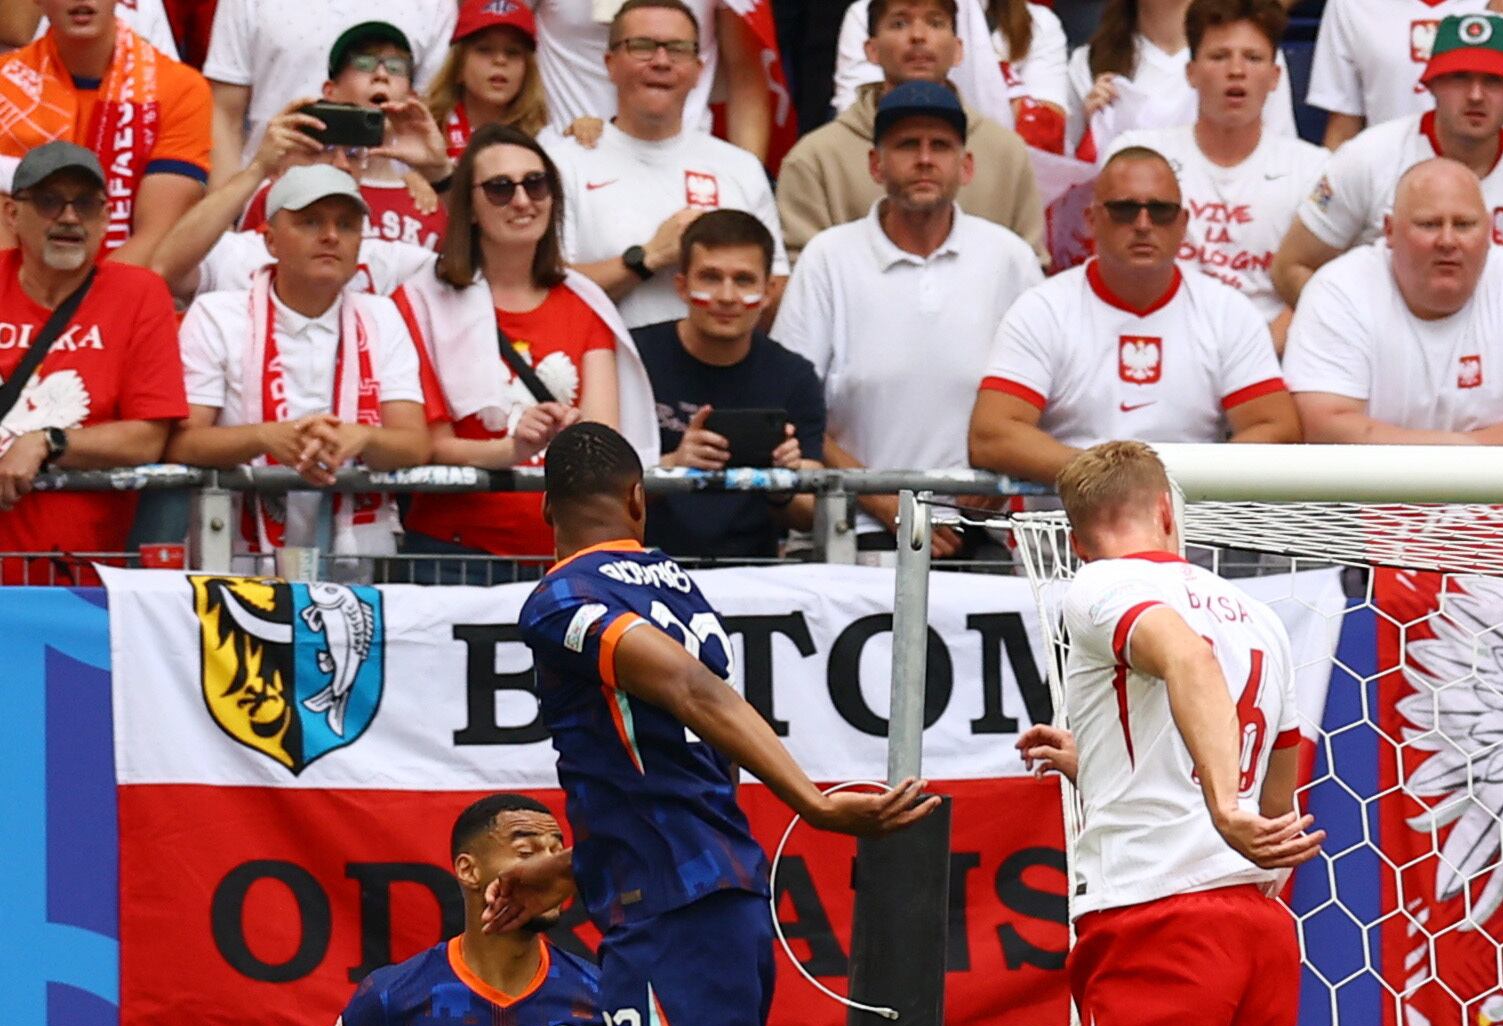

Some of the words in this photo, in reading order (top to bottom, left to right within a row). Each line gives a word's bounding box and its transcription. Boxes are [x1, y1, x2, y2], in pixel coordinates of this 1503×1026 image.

[1189, 199, 1253, 224] VIVE
[361, 209, 440, 252] LSK
[1205, 226, 1233, 244] LA
[1174, 242, 1275, 271] OLOGN
[453, 607, 1069, 746] BTOM
